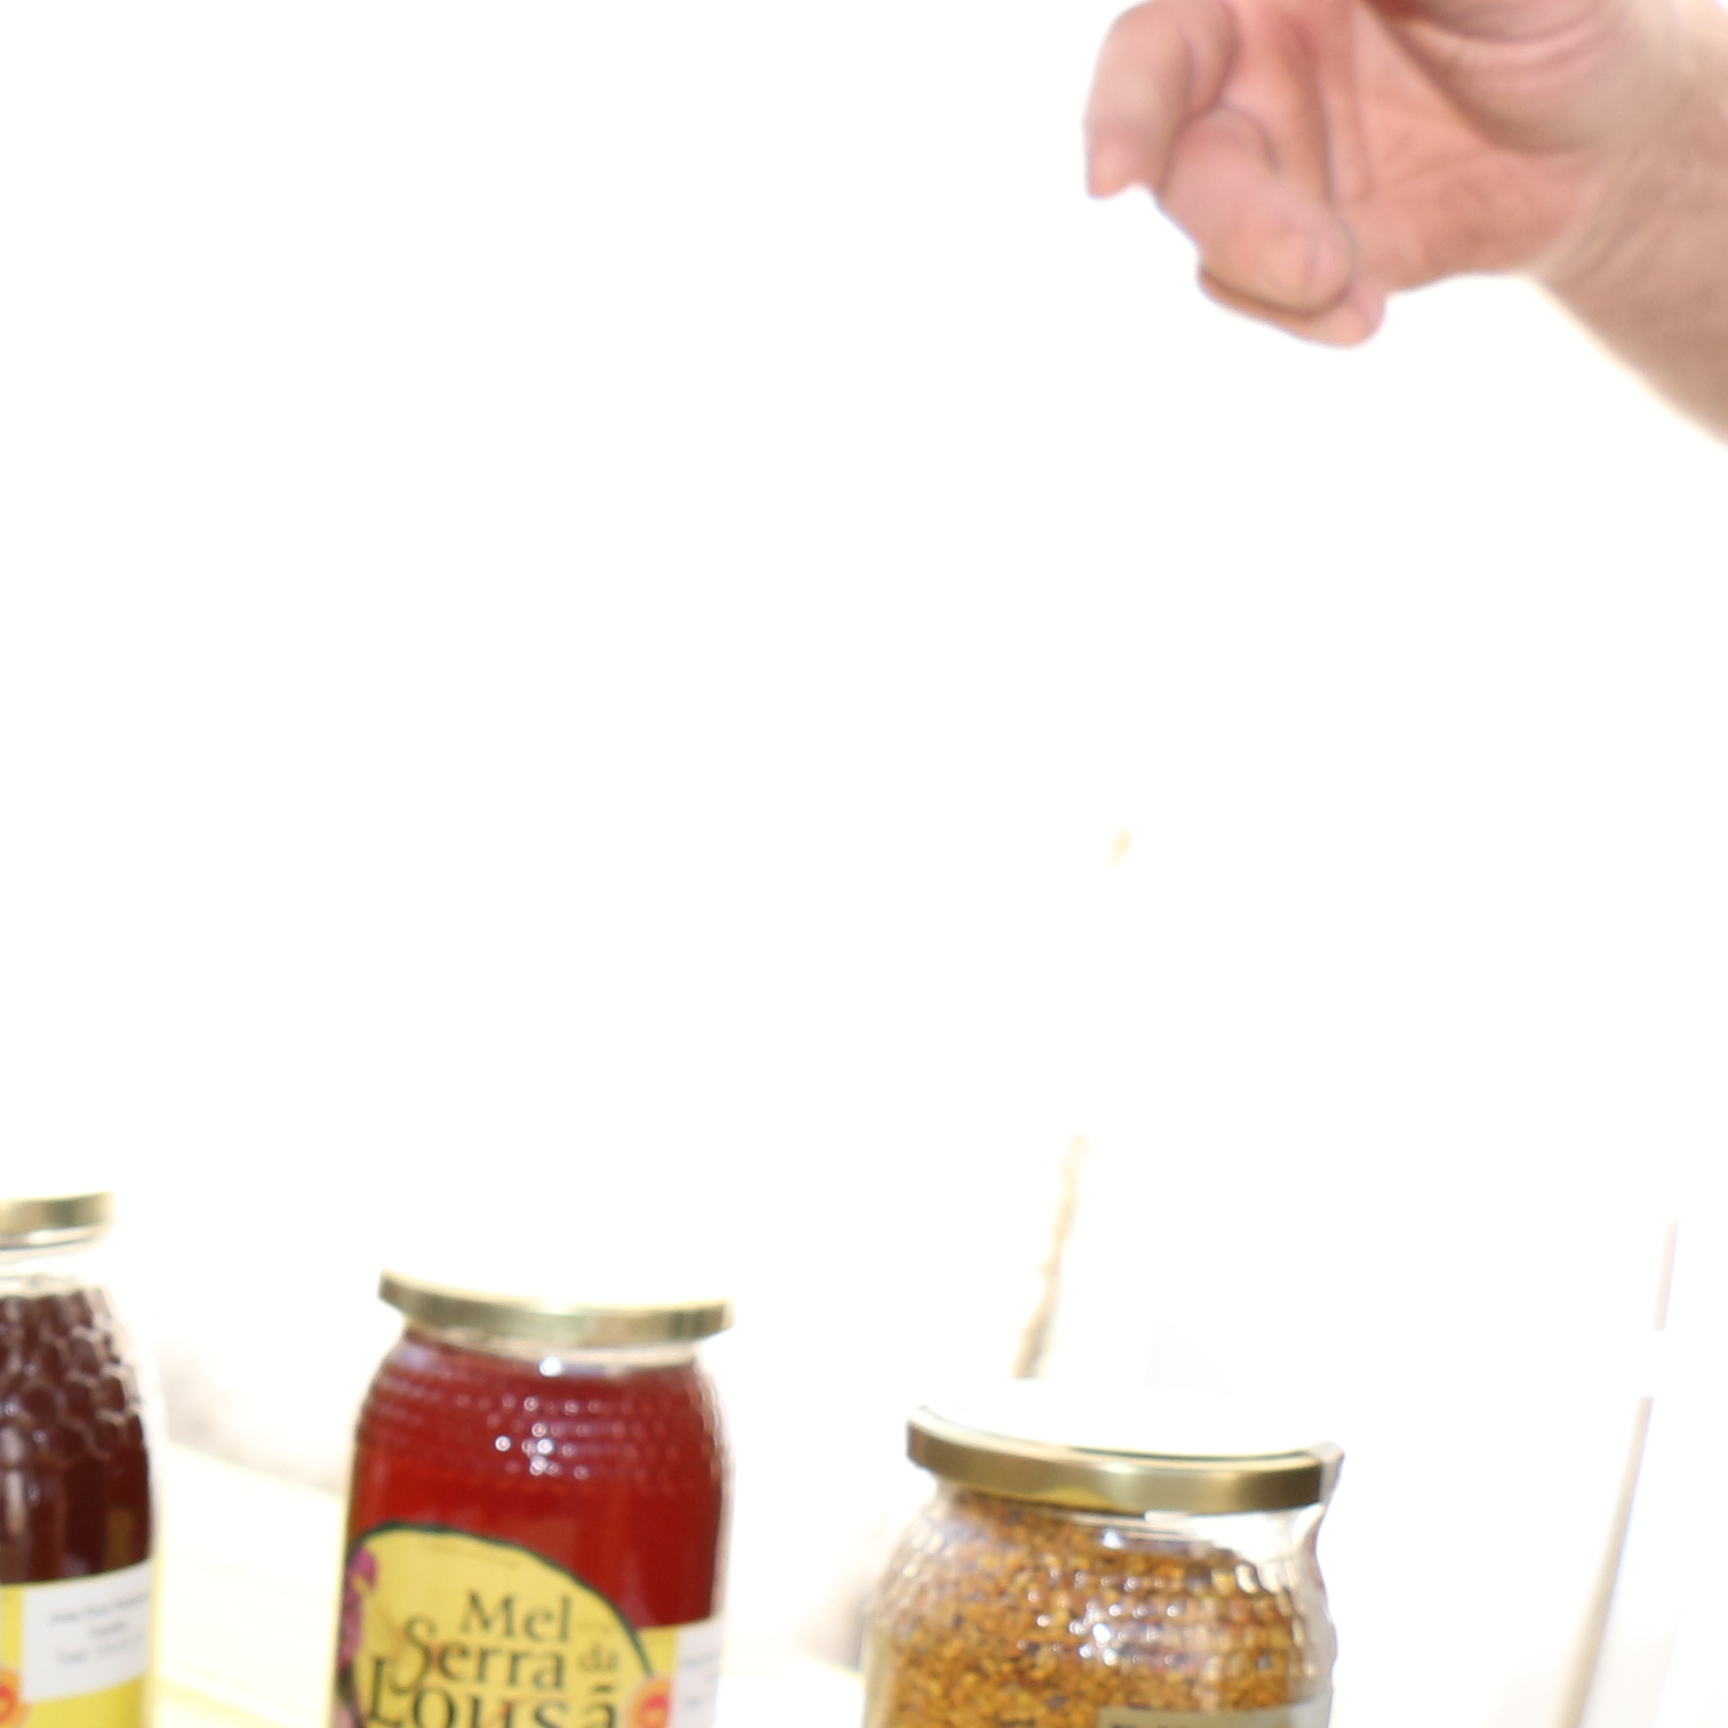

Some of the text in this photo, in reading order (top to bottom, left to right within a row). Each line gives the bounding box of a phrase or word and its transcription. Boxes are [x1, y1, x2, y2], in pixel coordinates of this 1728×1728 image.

[460, 1590, 573, 1642] Mel
[388, 1615, 619, 1695] Serra da
